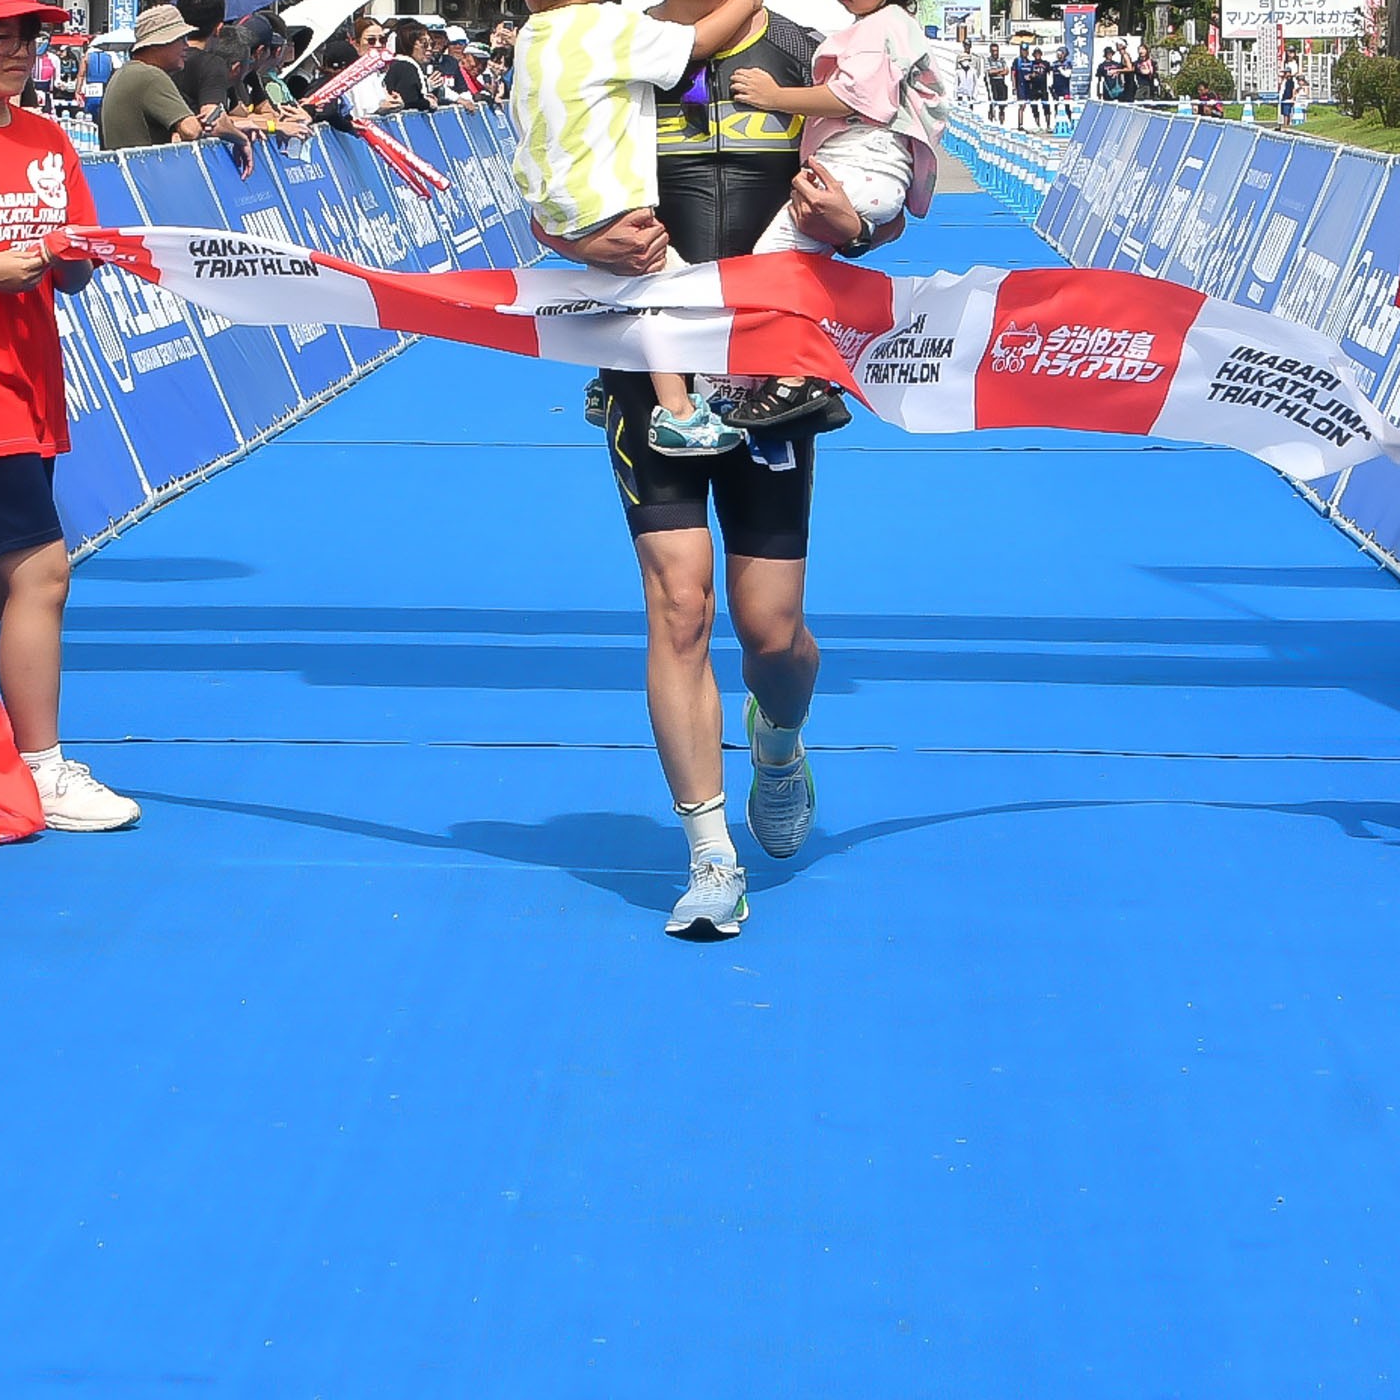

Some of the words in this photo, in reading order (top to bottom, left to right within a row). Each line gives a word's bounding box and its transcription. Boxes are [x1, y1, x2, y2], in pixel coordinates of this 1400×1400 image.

[193, 258, 320, 279] TRIATHLON
[1042, 324, 1157, 360] 今治伯方島
[863, 362, 941, 385] TRIATHLON
[1031, 355, 1166, 384] トライアスロン
[1228, 344, 1344, 392] IMABARI
[1205, 381, 1355, 449] TRIATHLON
[1214, 361, 1374, 442] HAKATAJIMA
